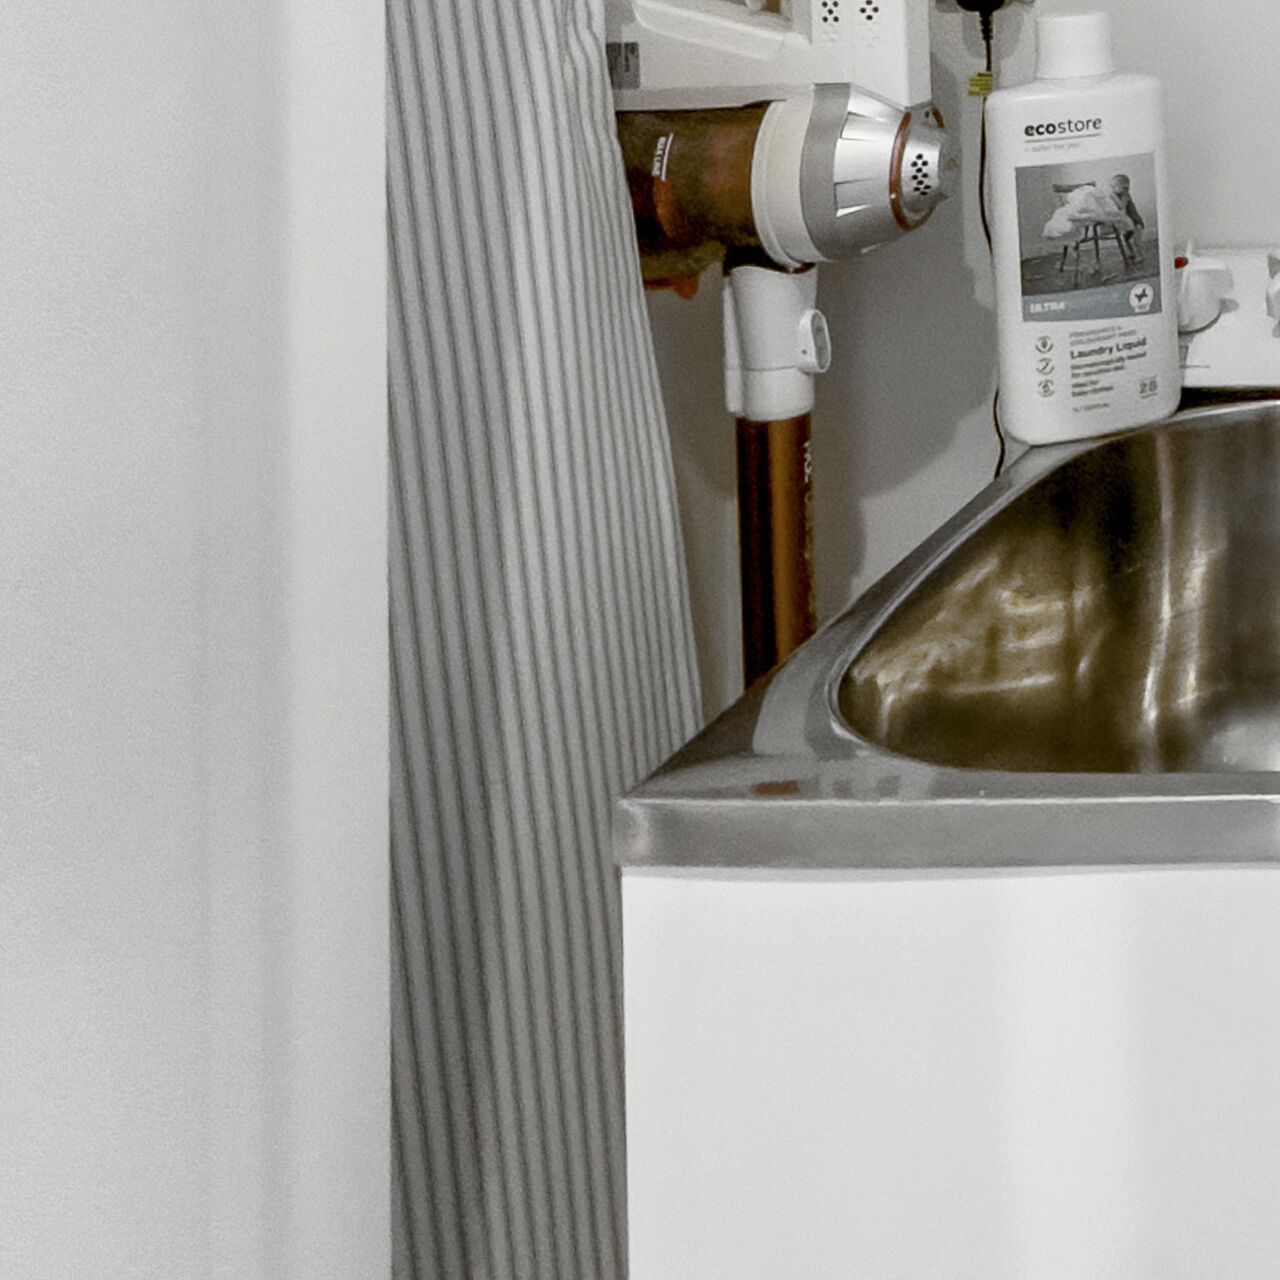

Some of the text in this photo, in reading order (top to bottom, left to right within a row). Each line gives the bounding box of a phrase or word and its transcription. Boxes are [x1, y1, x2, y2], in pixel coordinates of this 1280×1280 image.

[1024, 117, 1102, 137] ecostore
[1029, 301, 1066, 313] ULTRA
[1070, 337, 1147, 359] Laundry Liquid
